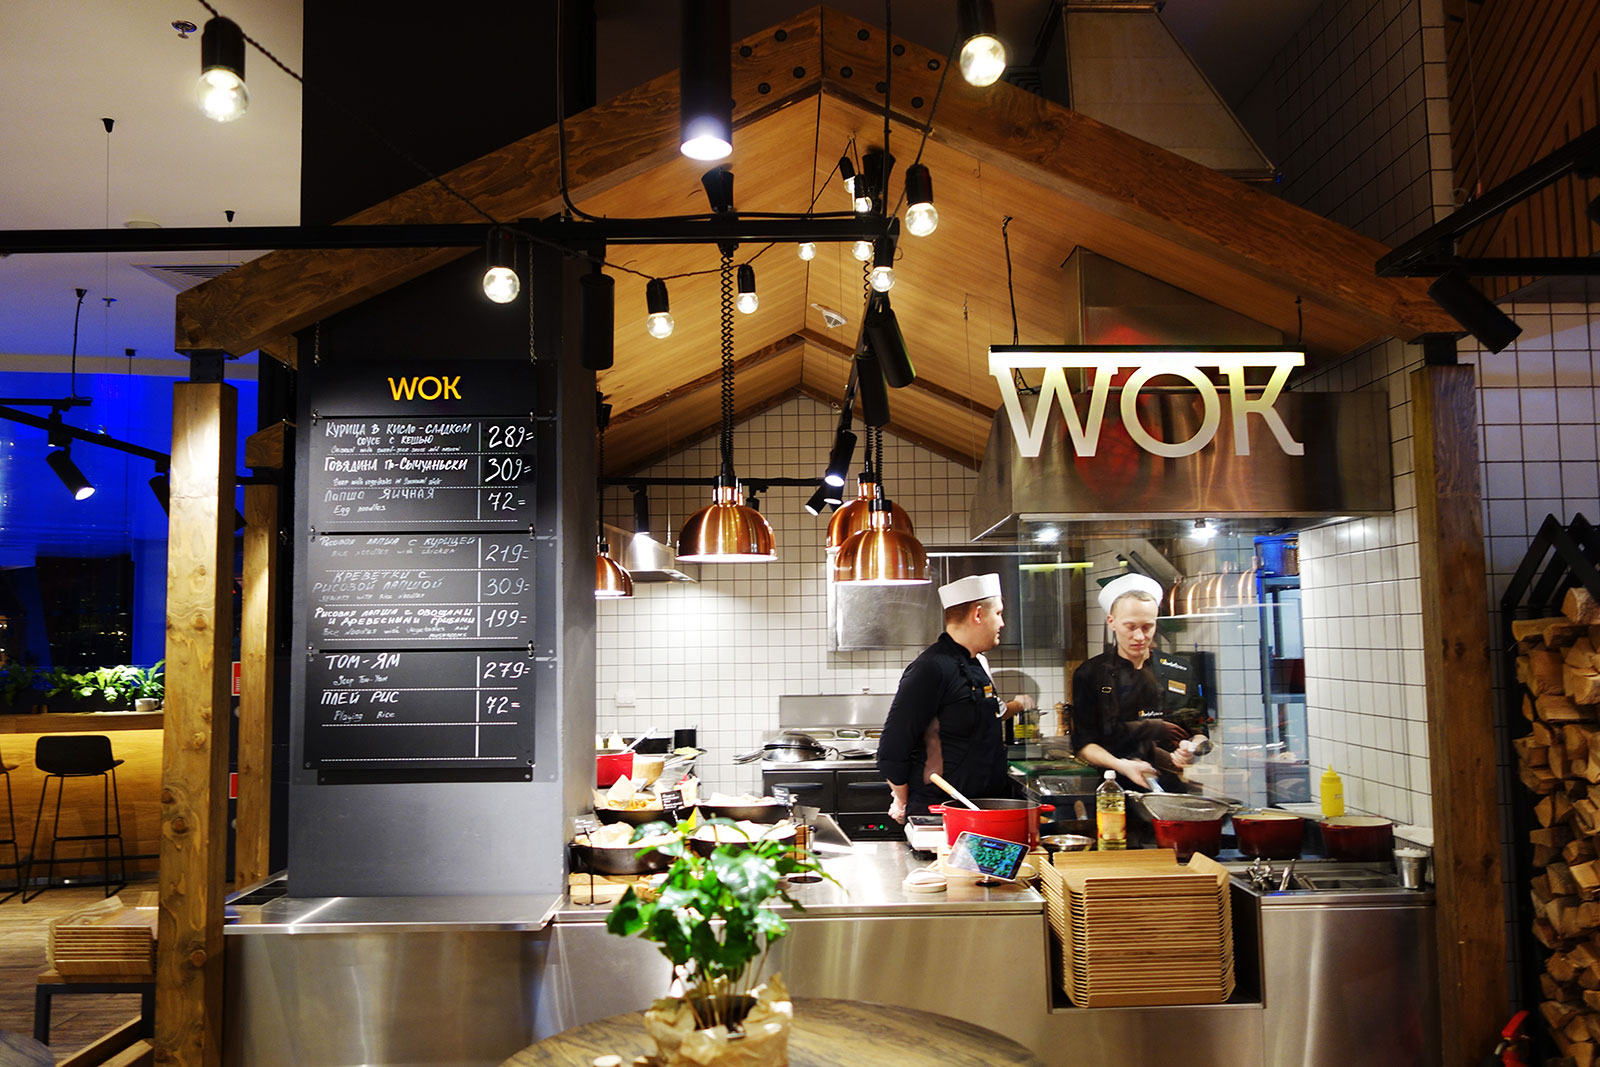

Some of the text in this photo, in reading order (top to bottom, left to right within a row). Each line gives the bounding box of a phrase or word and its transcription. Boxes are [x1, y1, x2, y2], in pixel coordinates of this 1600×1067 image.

[387, 375, 462, 401] WOK
[988, 351, 1304, 458] WOK
[401, 435, 434, 445] КЕШЬЮ
[333, 505, 351, 516] Egg
[423, 536, 476, 548] КУРИЦЕЙ
[333, 571, 410, 583] КРЕВЕТКИ
[312, 576, 446, 593] РИСОВОЙ ЛАПШОЙ
[417, 608, 473, 617] ОВОЩАМИ
[320, 691, 399, 705] ПЛЕЙ РИС
[333, 710, 395, 723] Playing Rice
